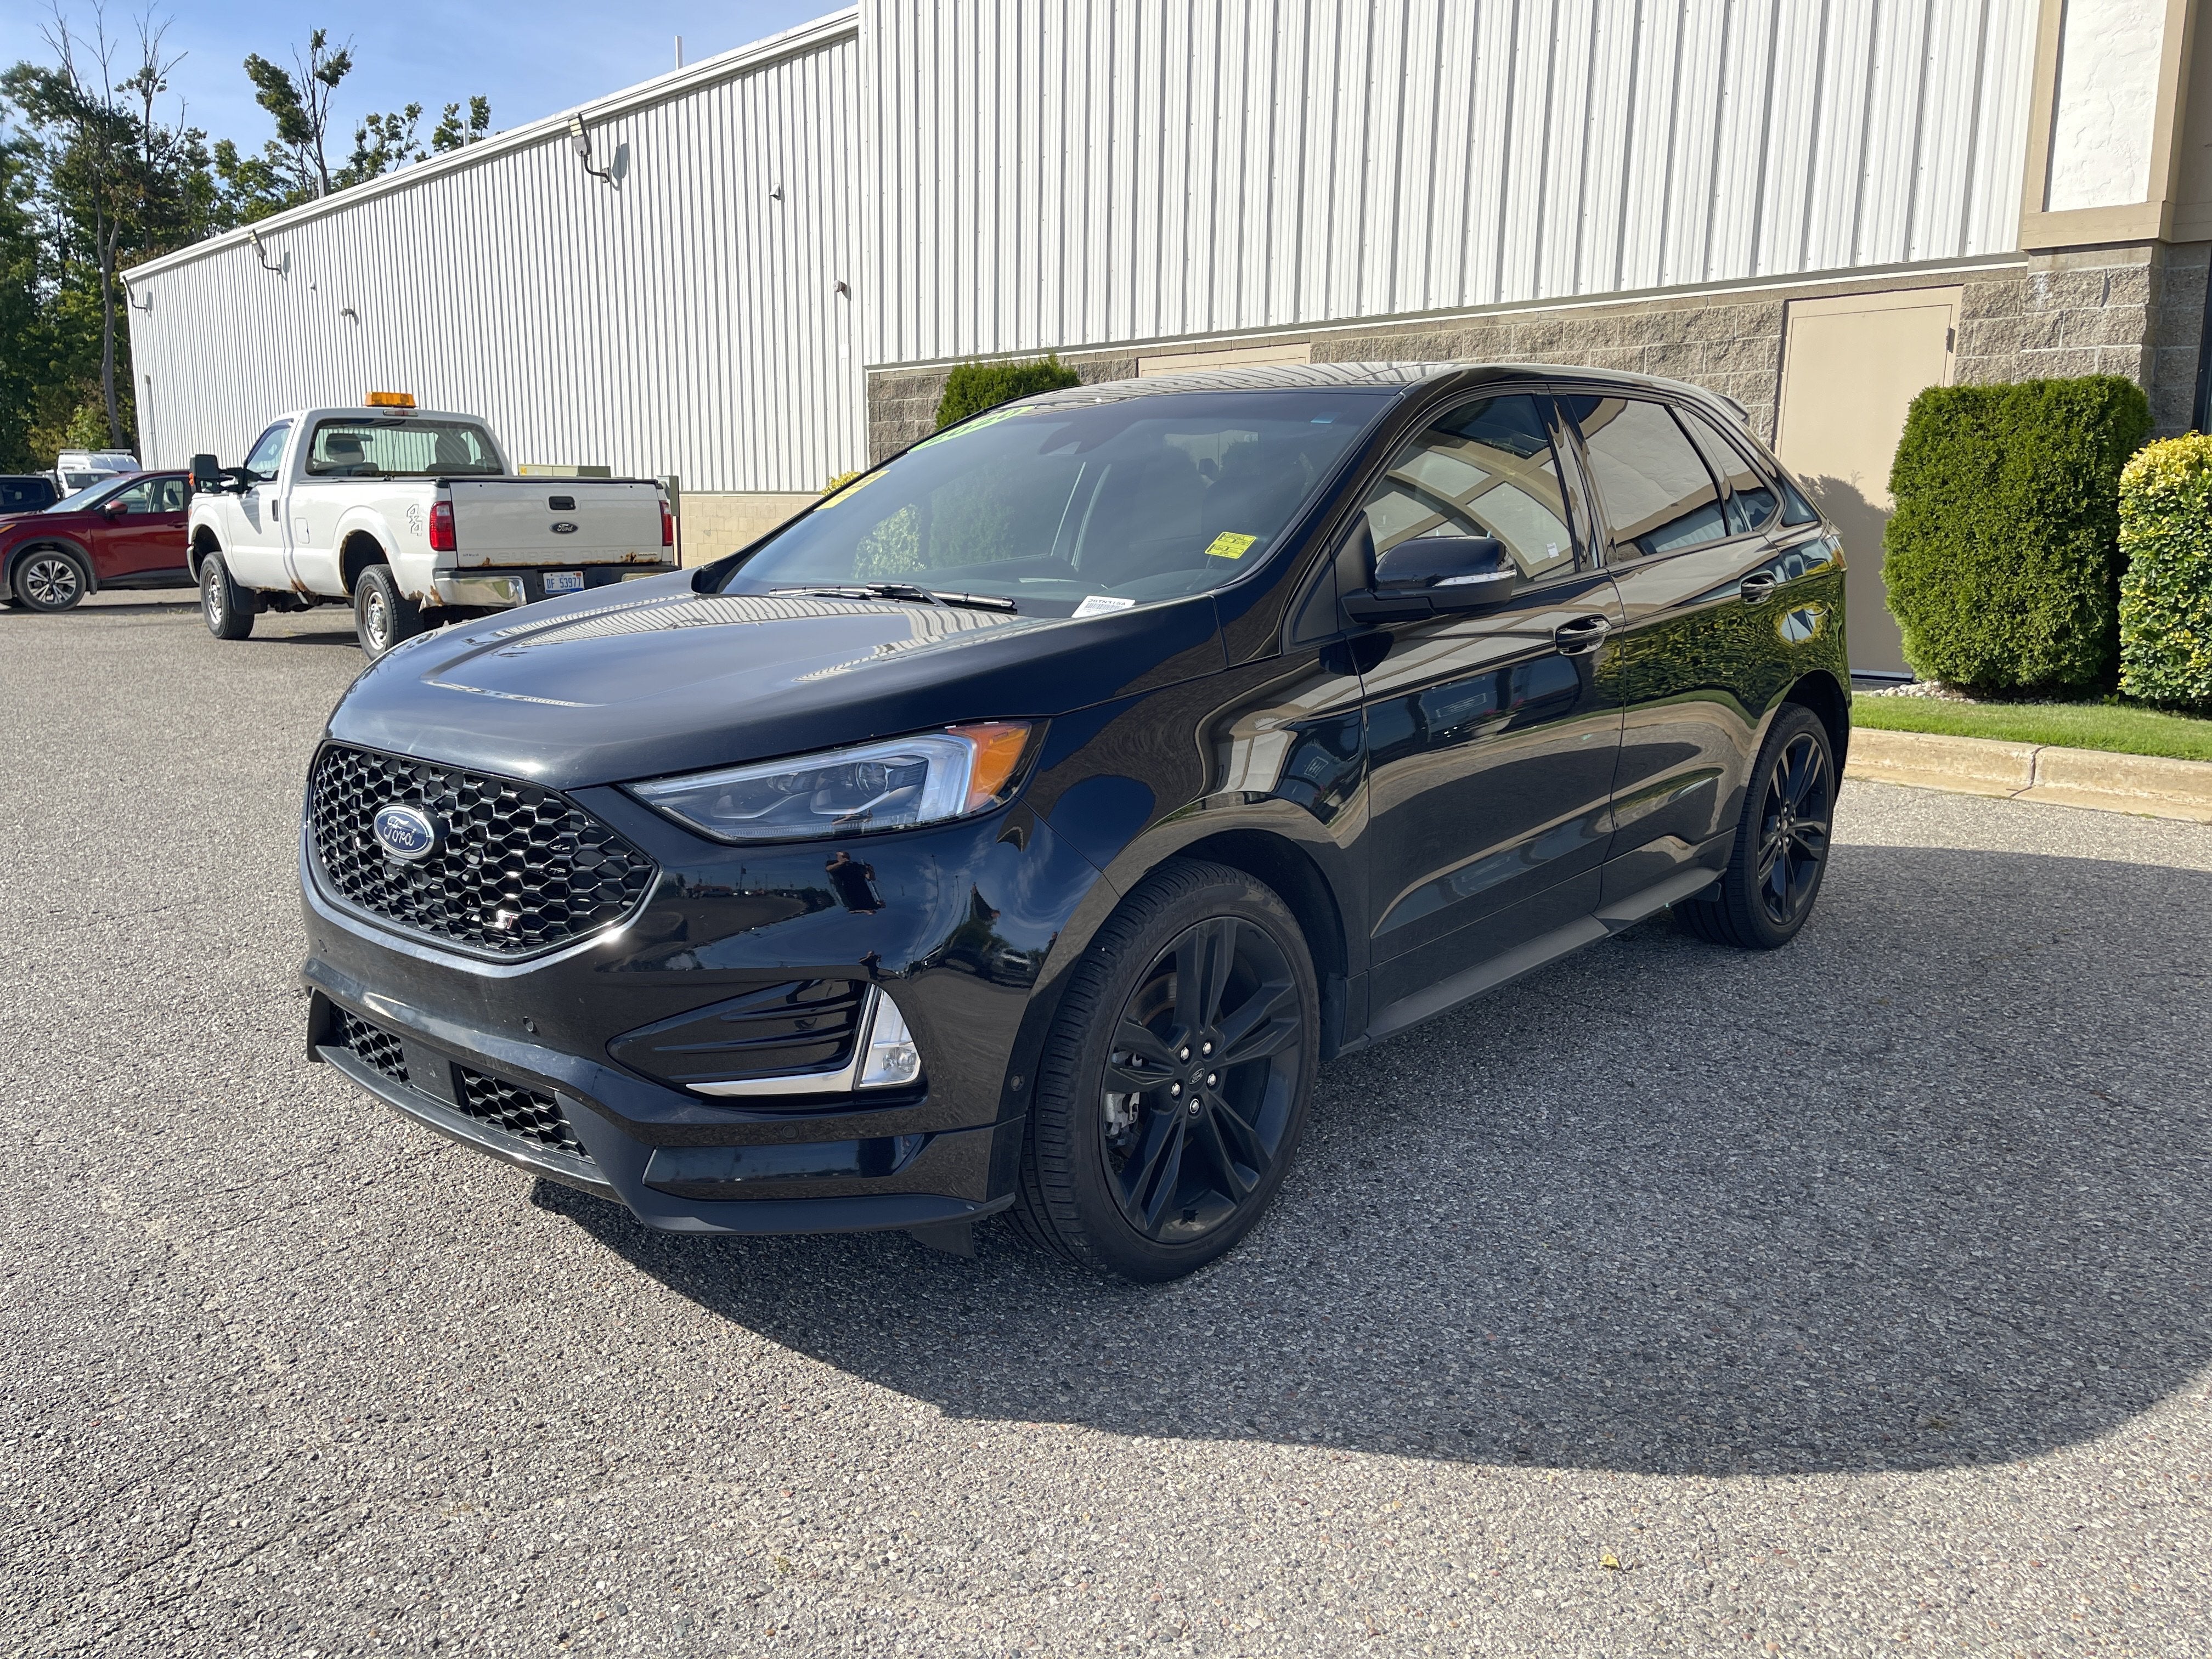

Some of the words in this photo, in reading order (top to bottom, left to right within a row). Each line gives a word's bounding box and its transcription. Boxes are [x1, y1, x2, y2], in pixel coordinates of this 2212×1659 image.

[559, 577, 581, 589] 53977
[383, 815, 416, 847] Ford
[494, 909, 519, 929] ST
